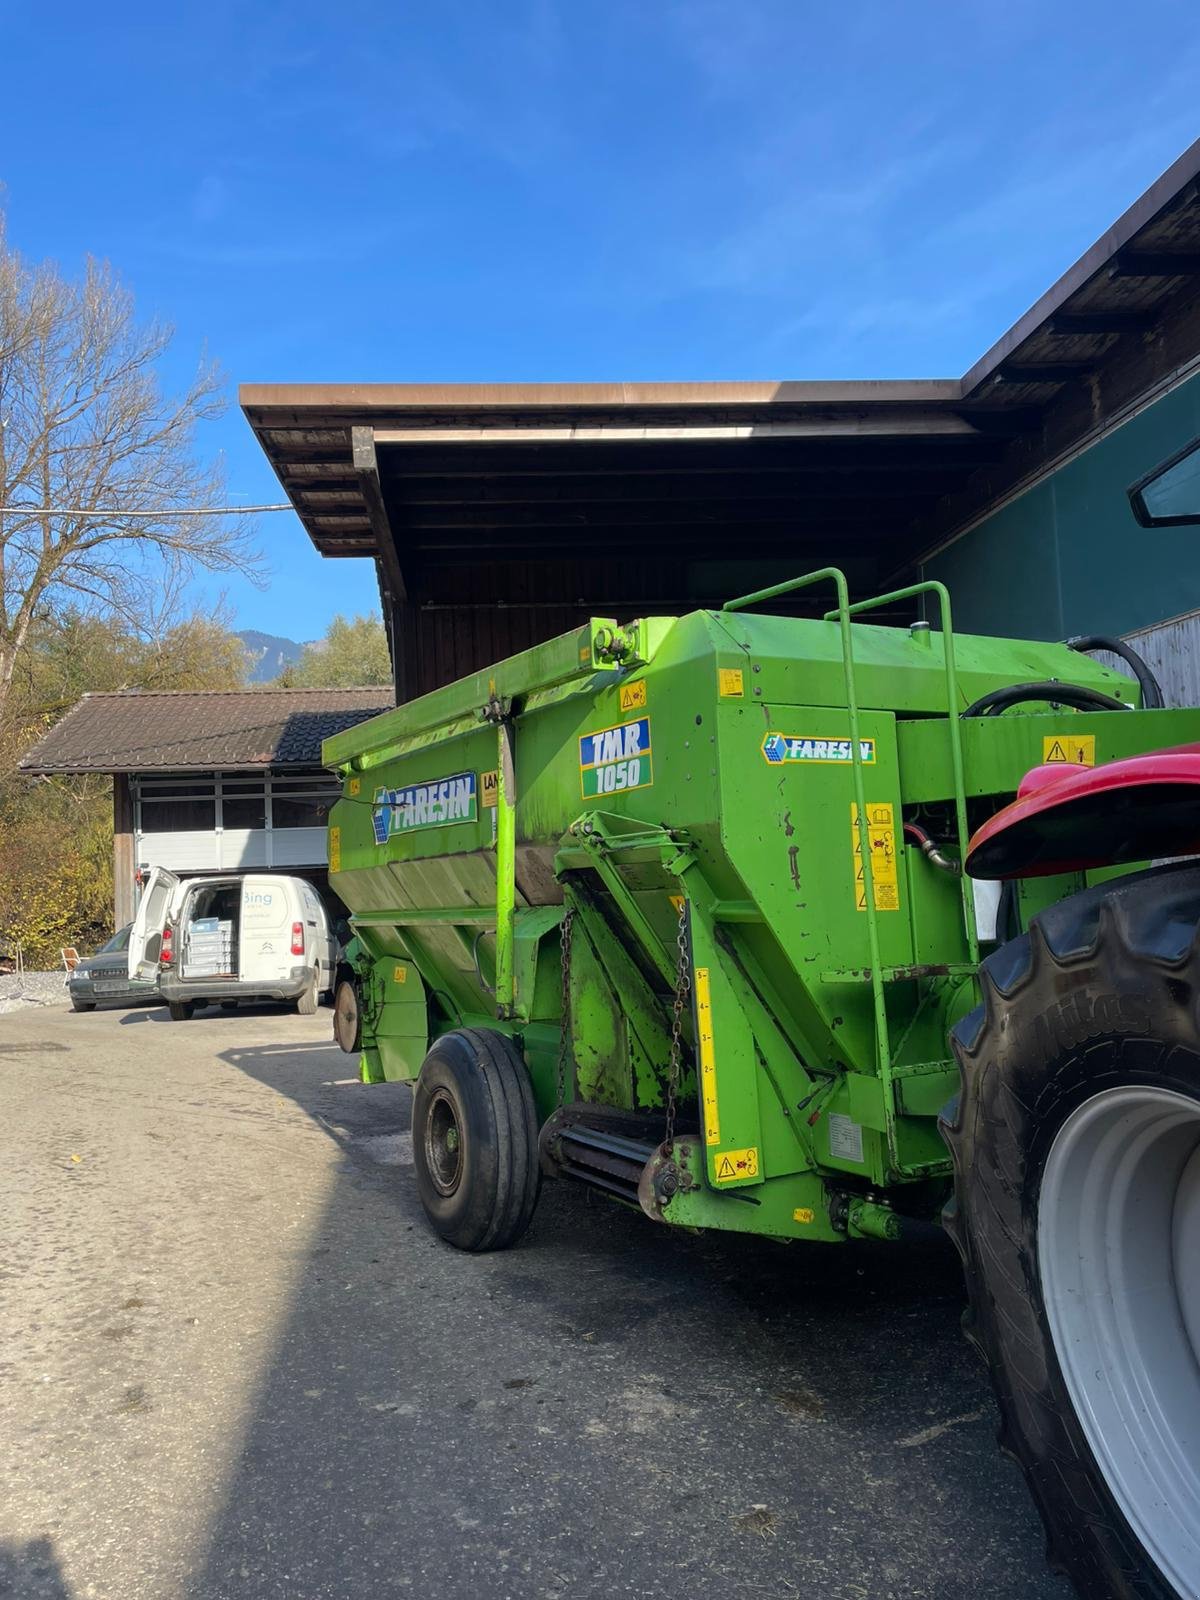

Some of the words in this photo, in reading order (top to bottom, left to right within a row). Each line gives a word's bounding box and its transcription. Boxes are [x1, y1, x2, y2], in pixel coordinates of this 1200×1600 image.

[592, 723, 641, 768] TMR
[596, 758, 641, 794] 1050
[393, 776, 471, 829] FARESIN
